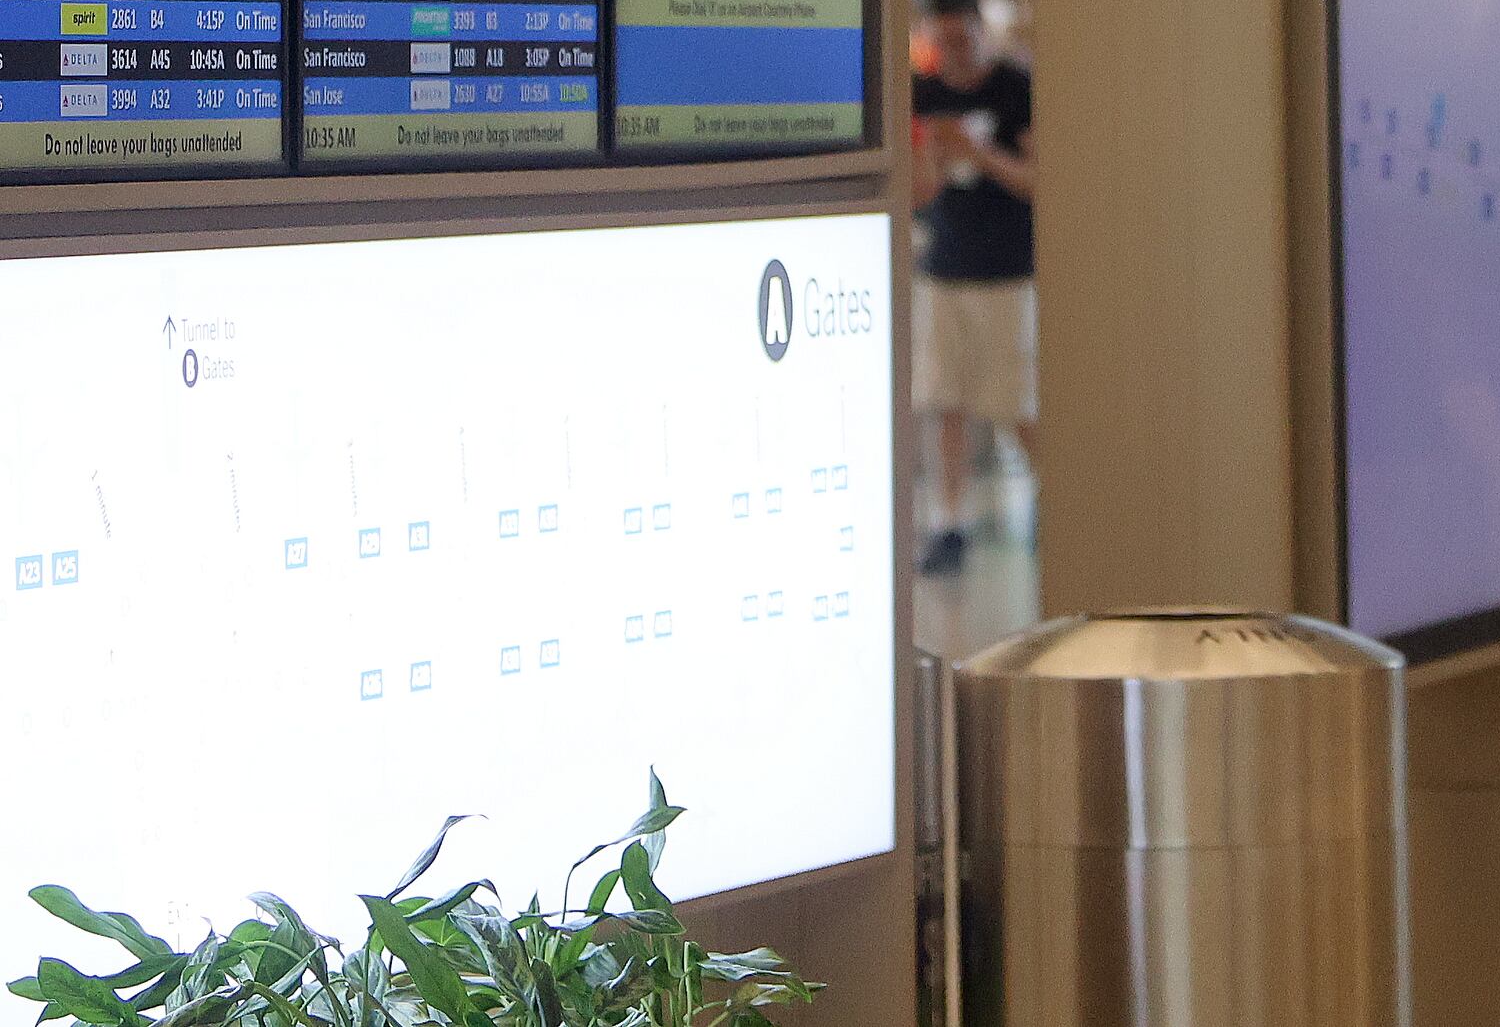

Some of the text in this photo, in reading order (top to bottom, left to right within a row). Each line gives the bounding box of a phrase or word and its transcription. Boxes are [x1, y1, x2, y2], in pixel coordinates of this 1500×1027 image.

[73, 8, 277, 31] spirit 2861 B4 4:15P On Time
[303, 9, 366, 29] San Francisco
[71, 48, 277, 70] DELTA 3614 A45 10:45A On Time
[304, 47, 366, 67] San Francisco
[304, 85, 343, 105] San Jose
[45, 131, 242, 157] Do not leave your bags unattended
[305, 126, 356, 149] 10:35 AM
[397, 124, 411, 146] Do
[414, 126, 430, 144] not
[433, 125, 460, 145] leave
[462, 128, 483, 147] your
[763, 272, 873, 346] A Gates
[181, 316, 236, 343] Tunnel to
[202, 355, 235, 381] Gates
[18, 560, 42, 586] A23
[55, 557, 77, 581] A25
